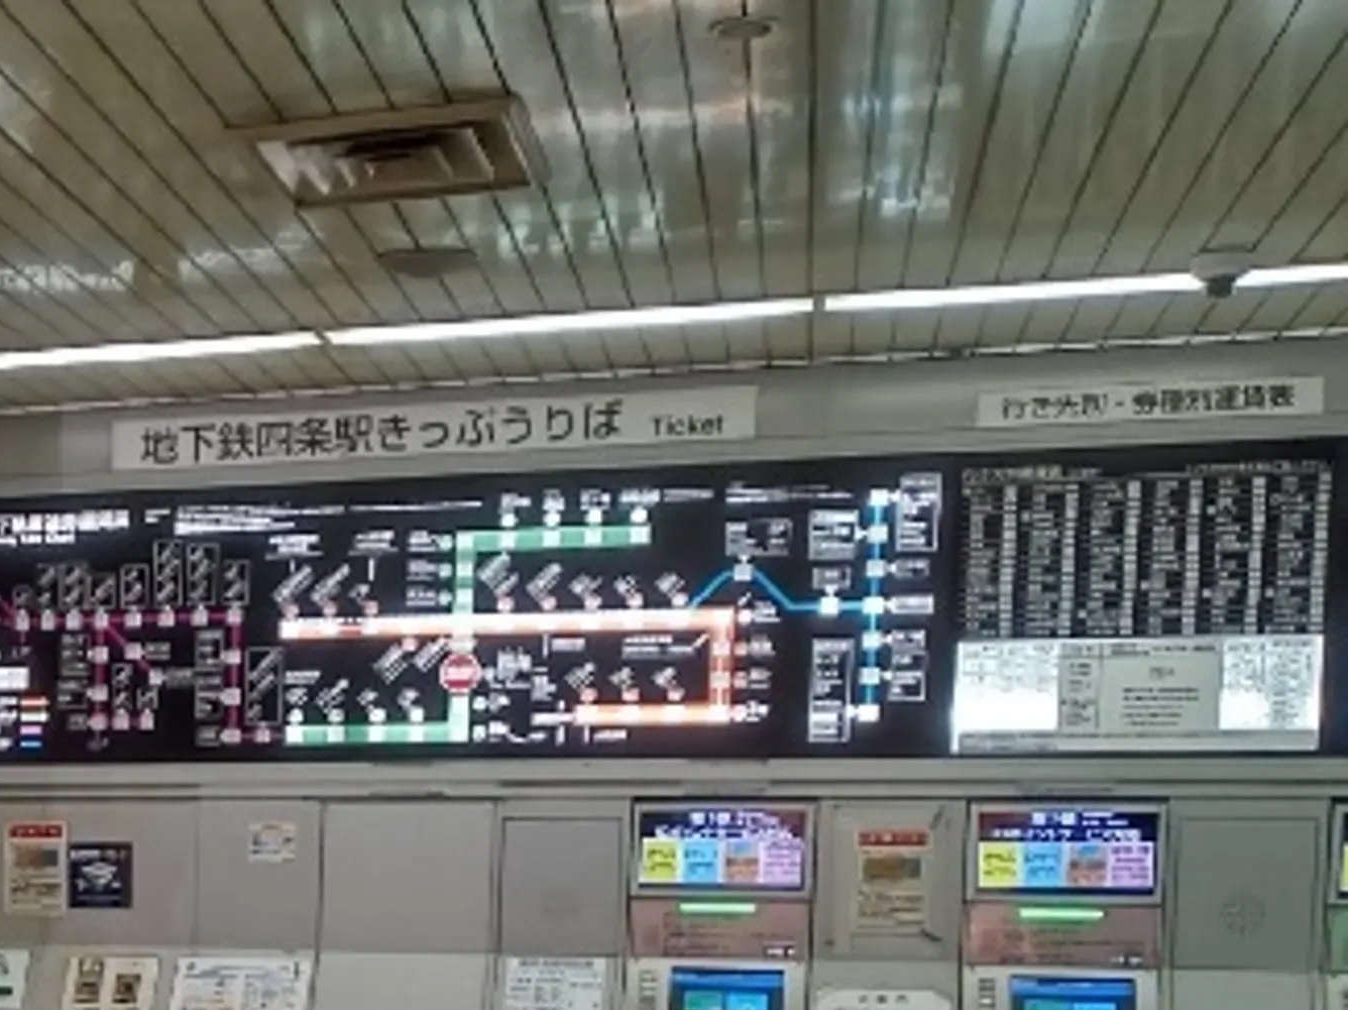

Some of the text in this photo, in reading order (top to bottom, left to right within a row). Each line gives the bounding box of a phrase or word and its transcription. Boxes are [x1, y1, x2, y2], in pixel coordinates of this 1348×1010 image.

[140, 399, 724, 464] 地下鉄四条駅きっぷうりば Ticket
